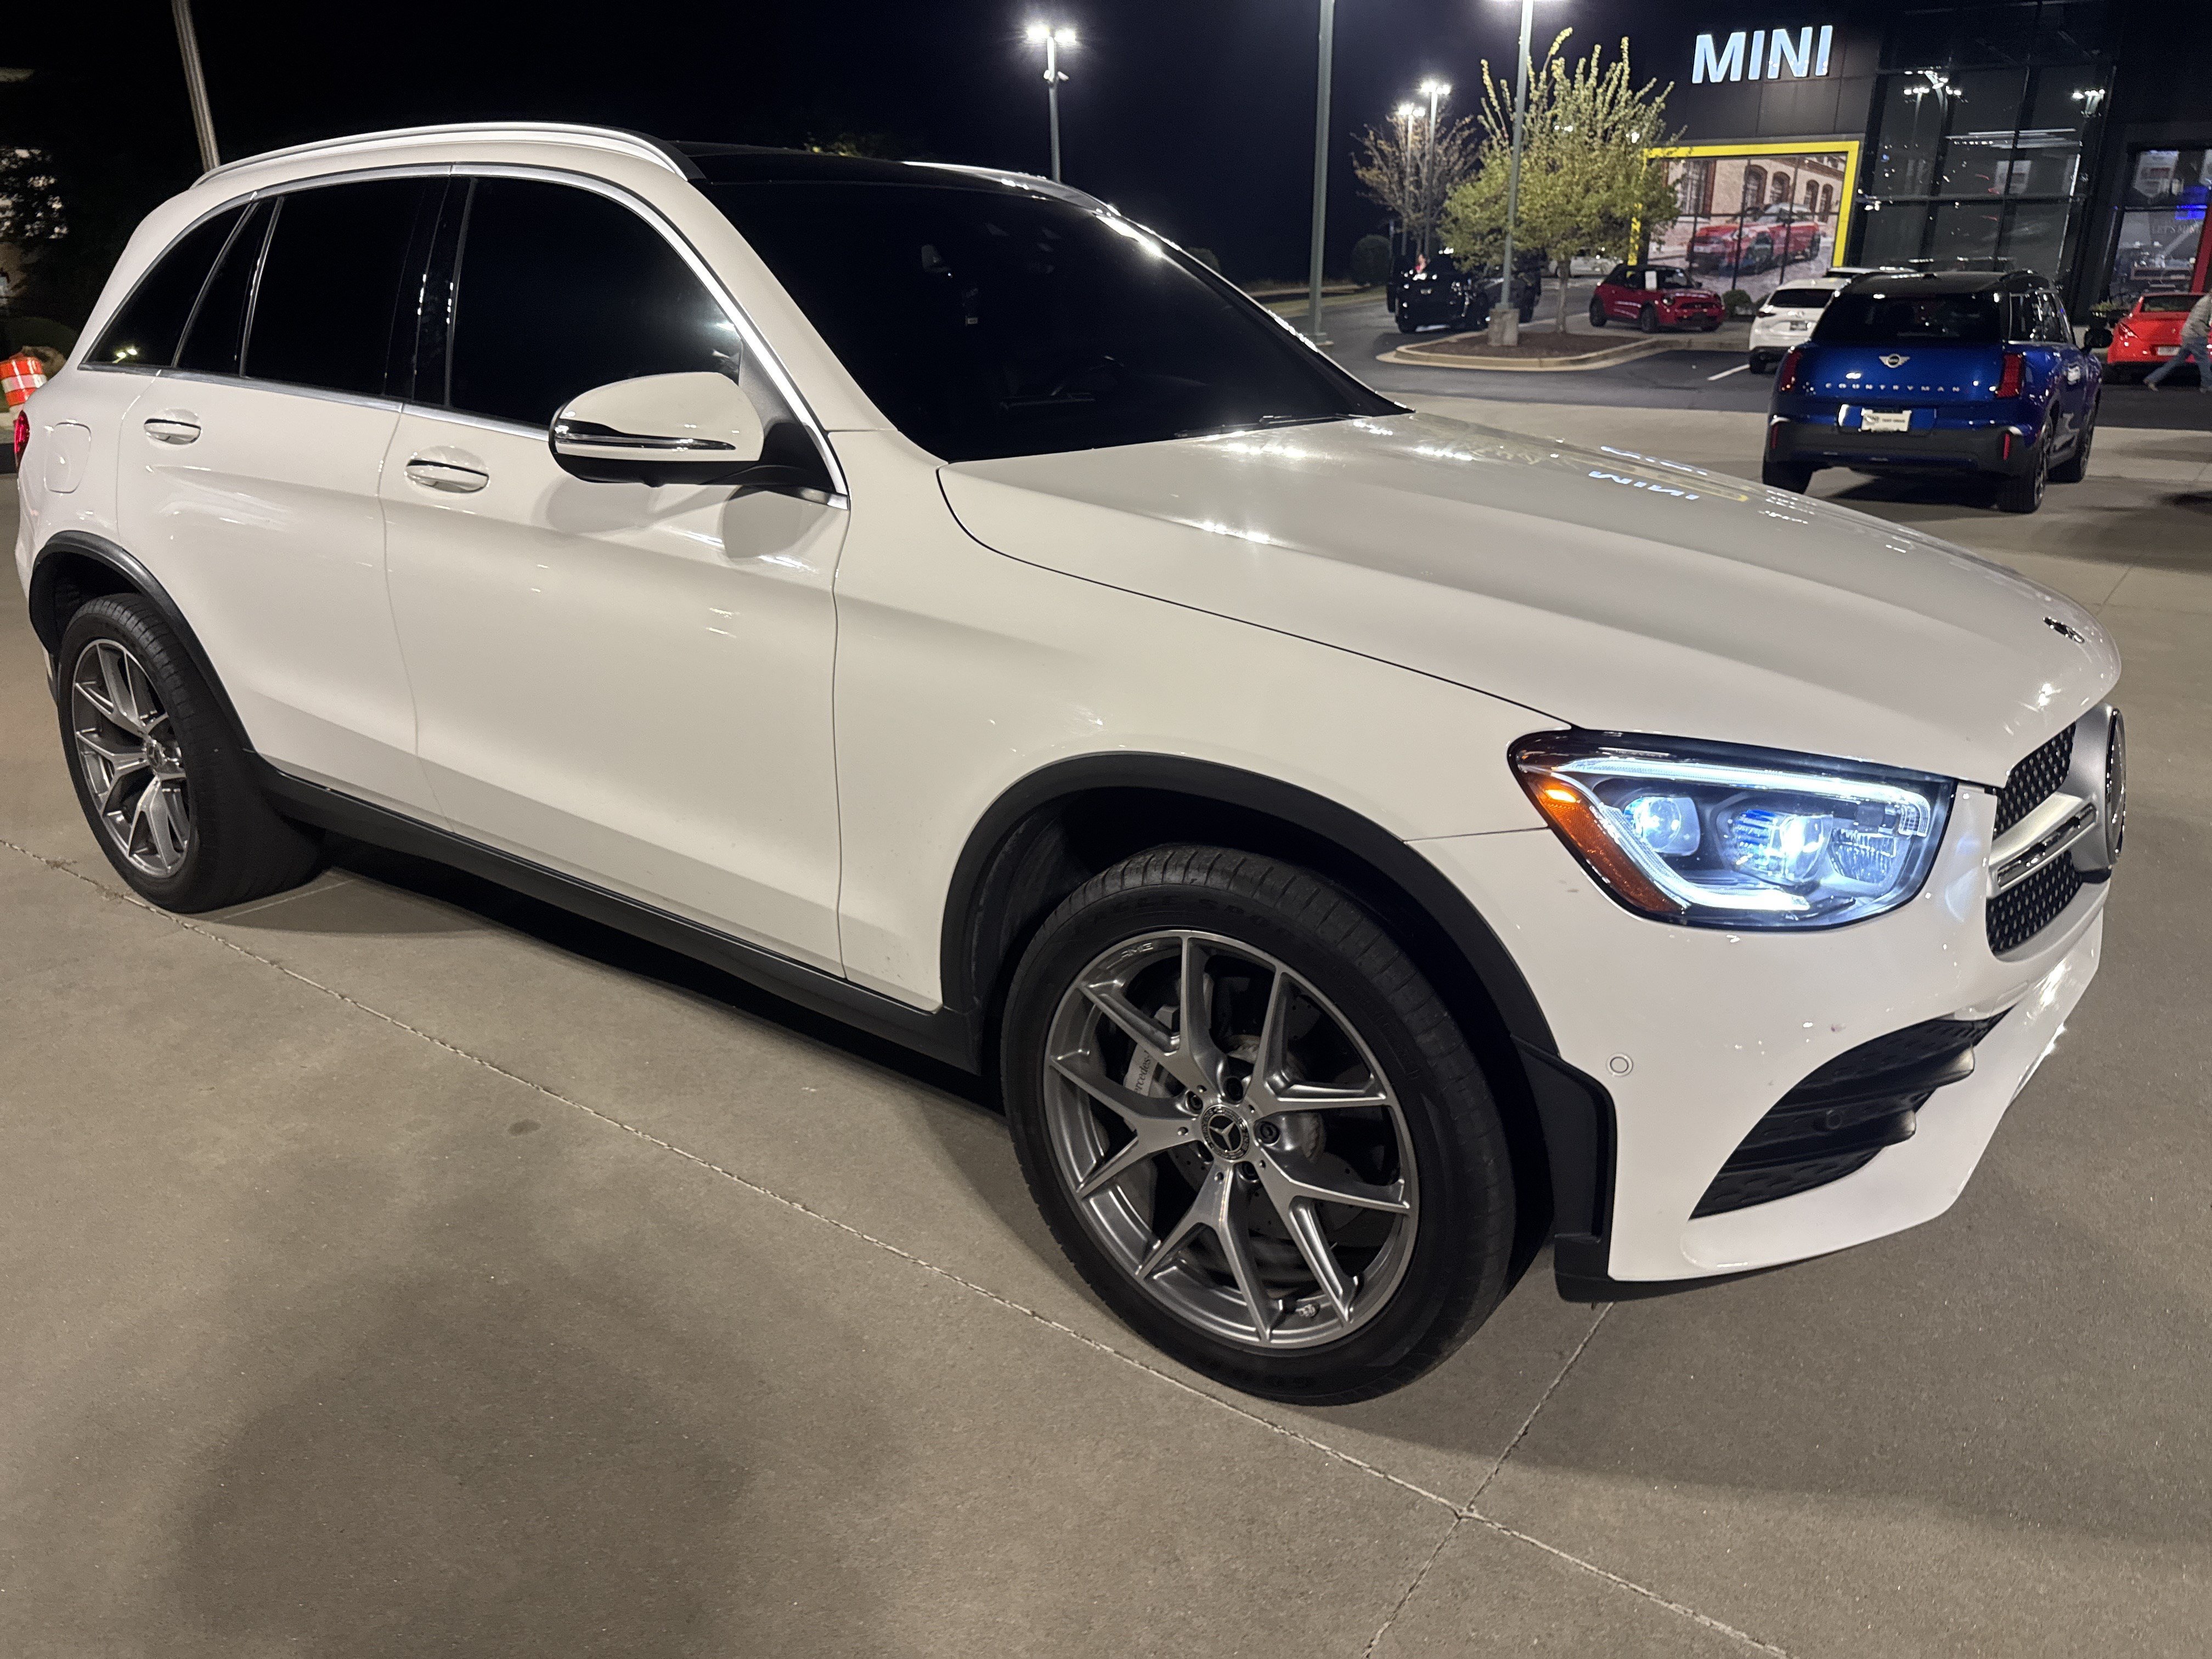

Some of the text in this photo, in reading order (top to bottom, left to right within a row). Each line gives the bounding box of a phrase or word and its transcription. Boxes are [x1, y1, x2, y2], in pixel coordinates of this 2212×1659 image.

[1692, 25, 1833, 84] MINI
[1825, 382, 1960, 392] COUNTRYMAN
[1121, 943, 1154, 958] AMG
[1135, 1050, 1151, 1093] ercedes-
